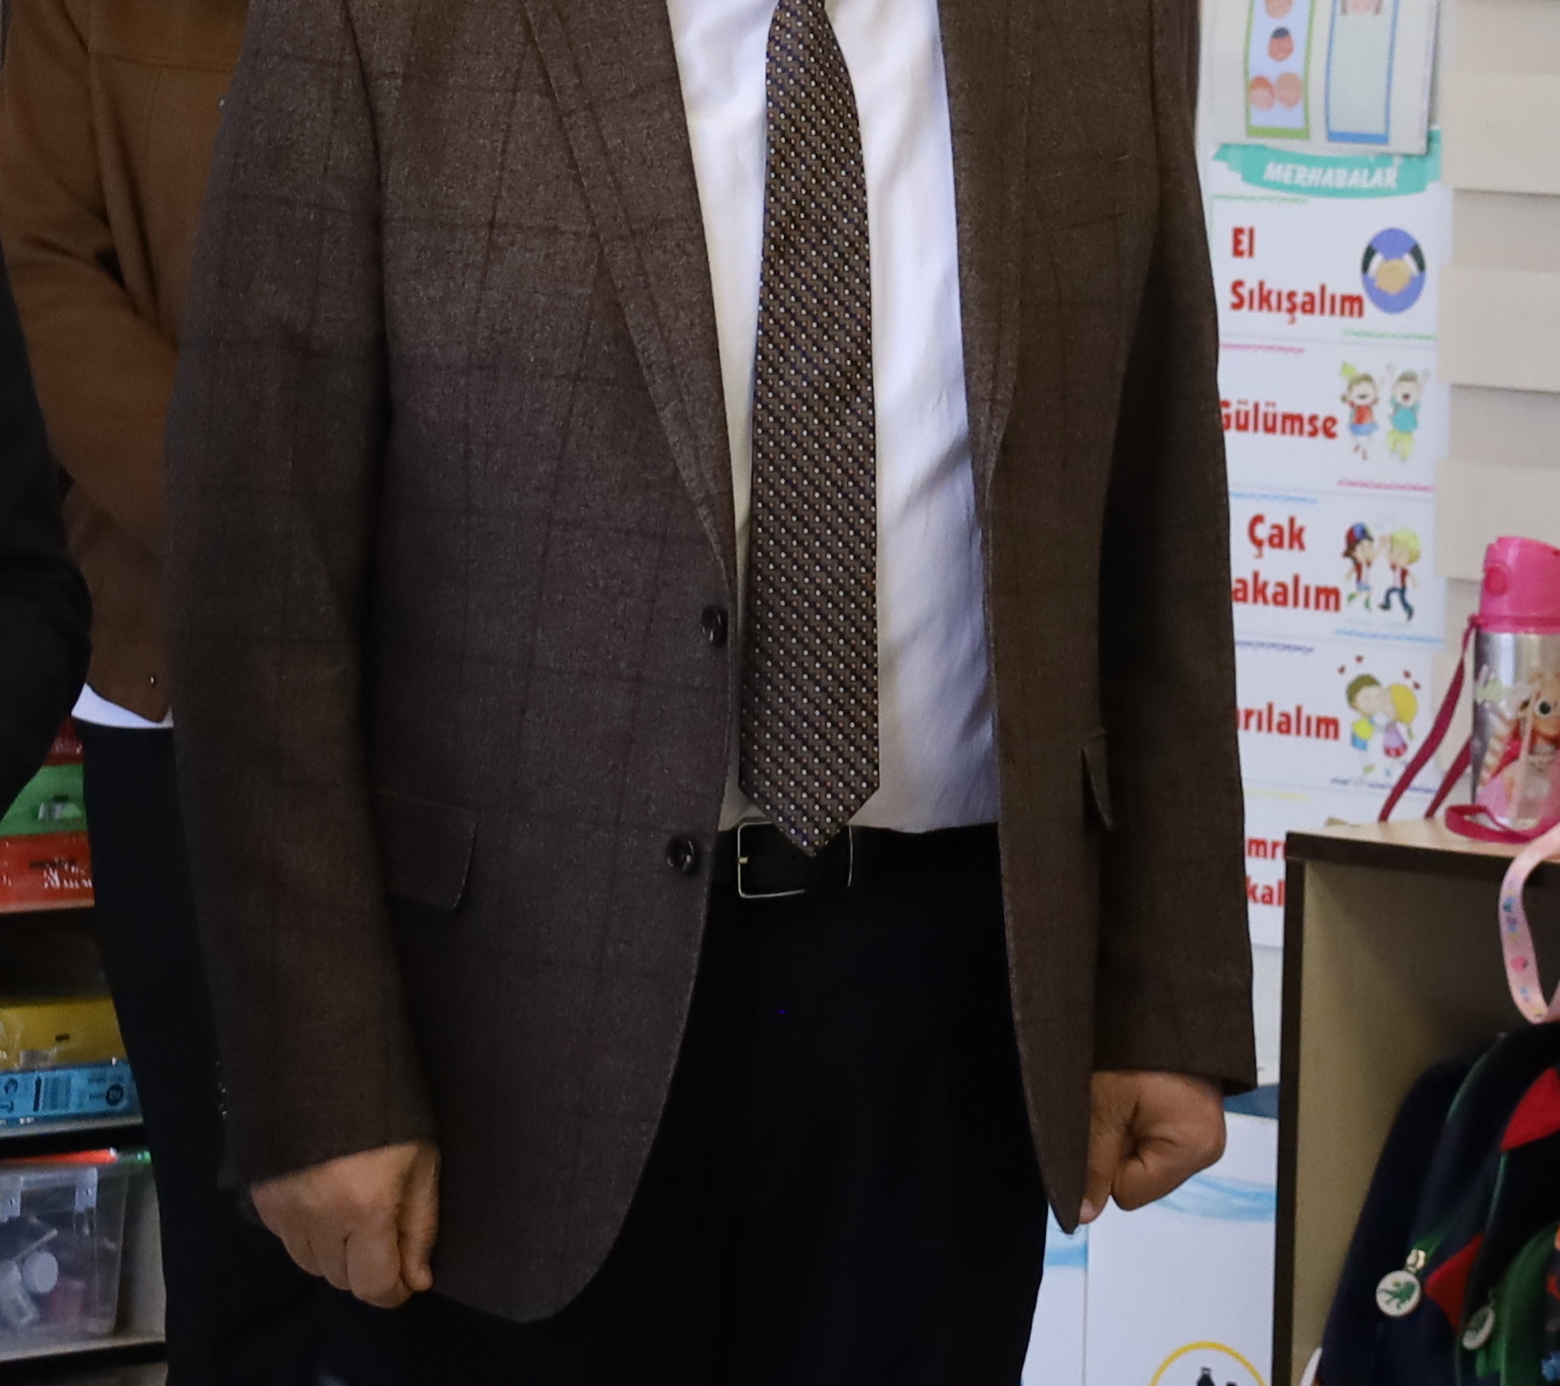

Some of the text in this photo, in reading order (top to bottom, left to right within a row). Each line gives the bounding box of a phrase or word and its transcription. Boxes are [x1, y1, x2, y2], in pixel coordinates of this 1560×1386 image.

[1264, 160, 1398, 190] MERHABALAR
[1232, 226, 1255, 259] El
[1230, 279, 1364, 324] Sıkışalım
[1248, 513, 1306, 559] Çak
[1232, 570, 1343, 612] akalım
[1236, 701, 1339, 741] rılalım
